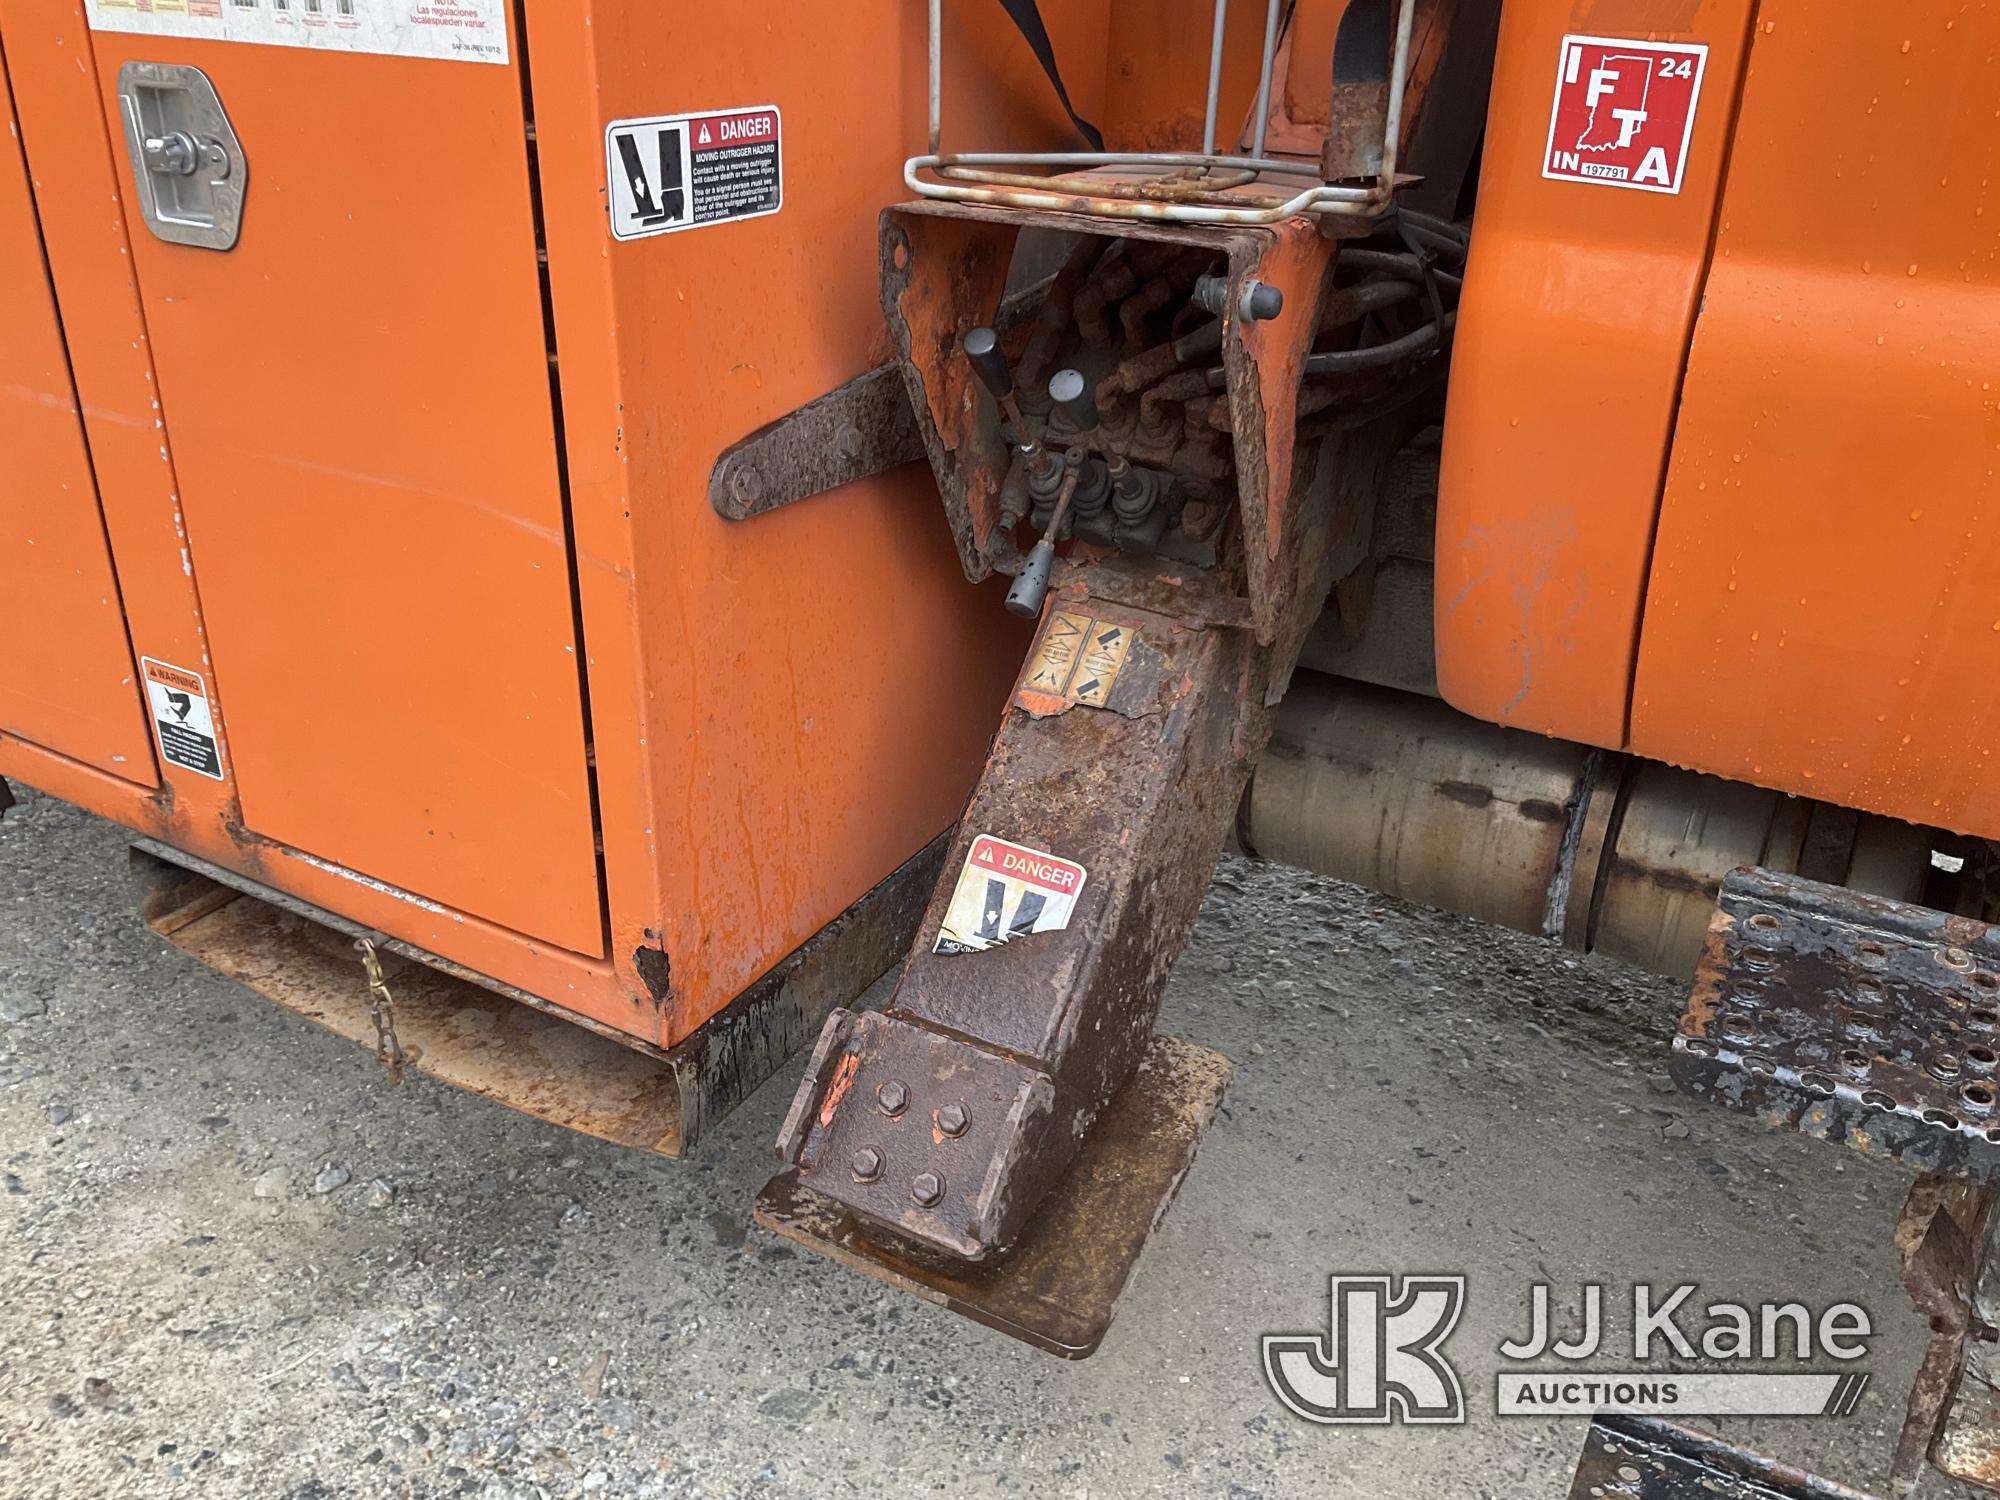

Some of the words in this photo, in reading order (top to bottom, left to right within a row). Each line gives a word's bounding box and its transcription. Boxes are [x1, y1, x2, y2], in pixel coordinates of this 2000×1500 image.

[416, 5, 430, 15] Las
[431, 7, 478, 19] regulaciones
[1657, 57, 1693, 79] 24
[720, 117, 771, 140] DANGER
[695, 151, 719, 163] MOVING
[719, 147, 752, 160] OUTRIGGER
[752, 144, 775, 155] HAZARD
[1552, 150, 1580, 171] IN
[692, 167, 714, 176] Contact
[714, 164, 726, 172] with
[730, 161, 749, 169] moving
[749, 159, 772, 168] outrigger
[703, 175, 720, 183] cause
[720, 172, 734, 180] death
[741, 169, 760, 177] serious
[1584, 164, 1626, 179] 197791
[716, 184, 732, 193] signal
[732, 182, 750, 191] person
[750, 179, 763, 187] must
[705, 193, 730, 204] personnel
[730, 191, 739, 199] and
[739, 187, 769, 197] obstructions
[724, 198, 747, 208] outrigger
[747, 195, 757, 203] and
[715, 209, 730, 217] point.
[157, 670, 200, 691] WARNING
[1002, 852, 1076, 888] DANGER
[943, 940, 980, 953] MOVIN
